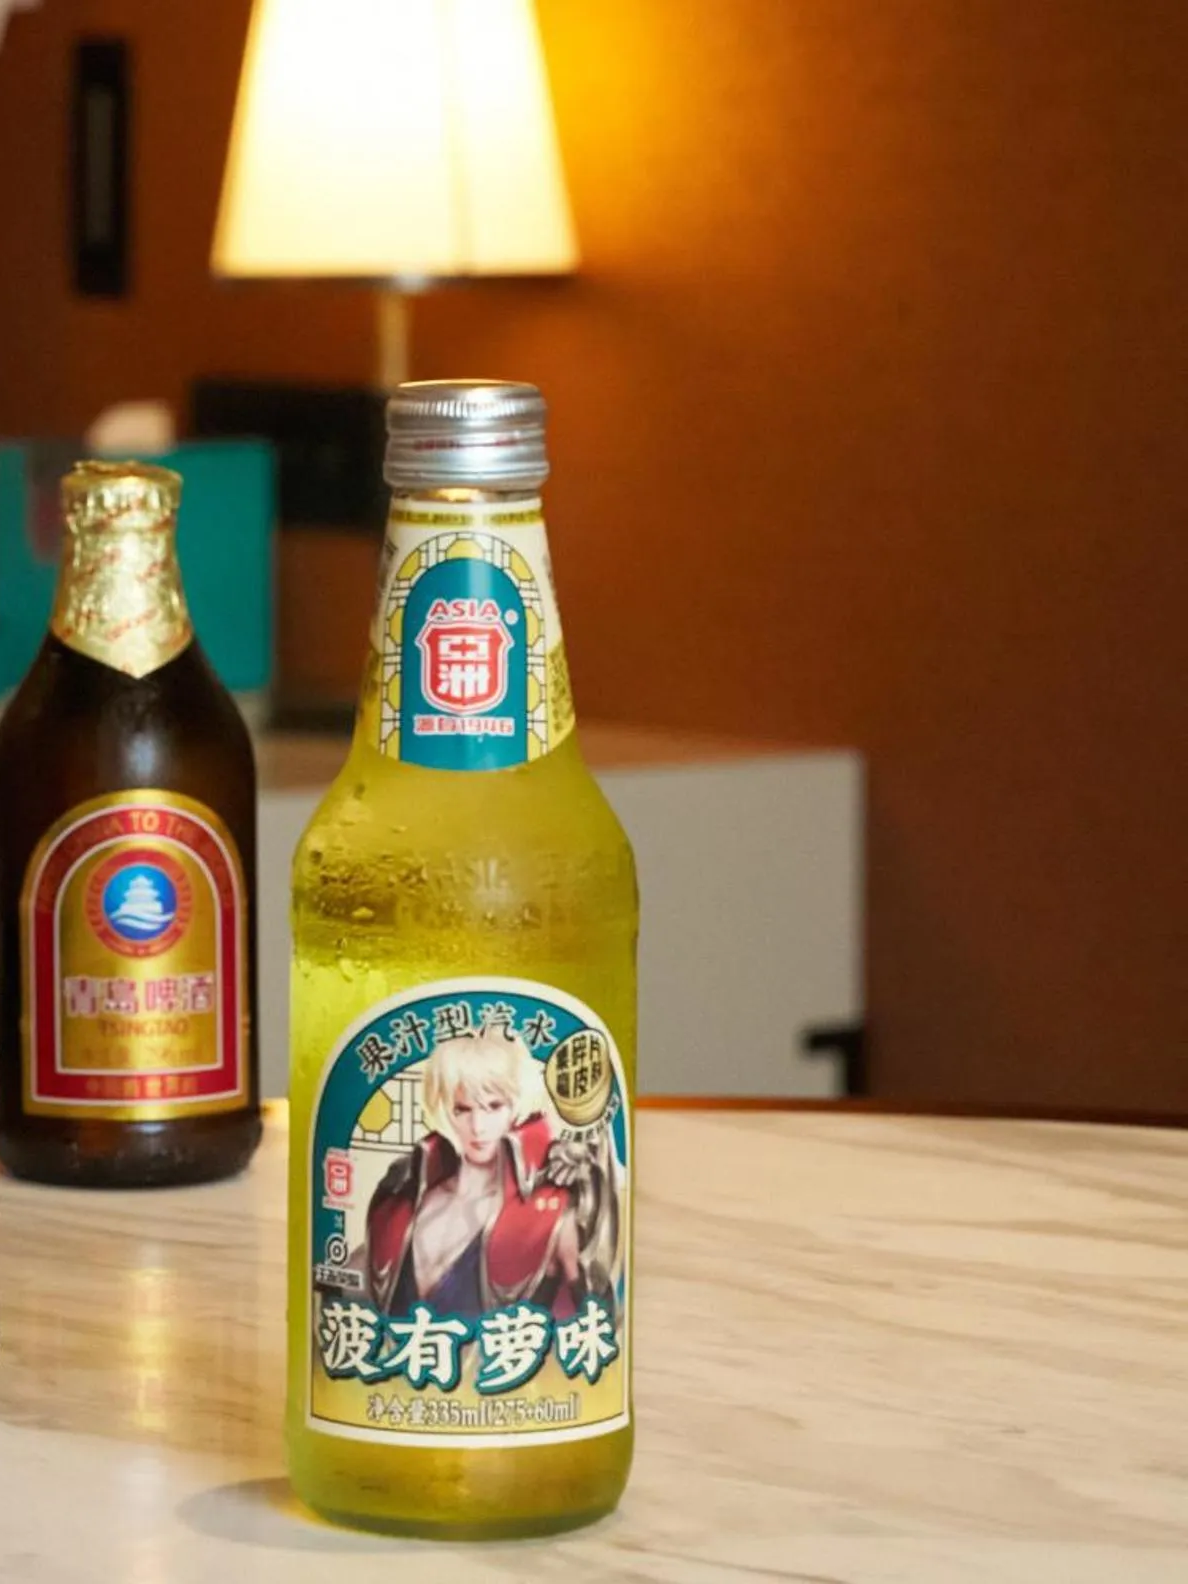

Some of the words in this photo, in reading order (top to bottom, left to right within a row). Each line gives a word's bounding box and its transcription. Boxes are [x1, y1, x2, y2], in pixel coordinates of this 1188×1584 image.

[430, 601, 499, 618] ASIA
[129, 811, 159, 832] TO
[357, 1002, 558, 1080] 果汁型汽水
[321, 1300, 617, 1395] 菠有萝味
